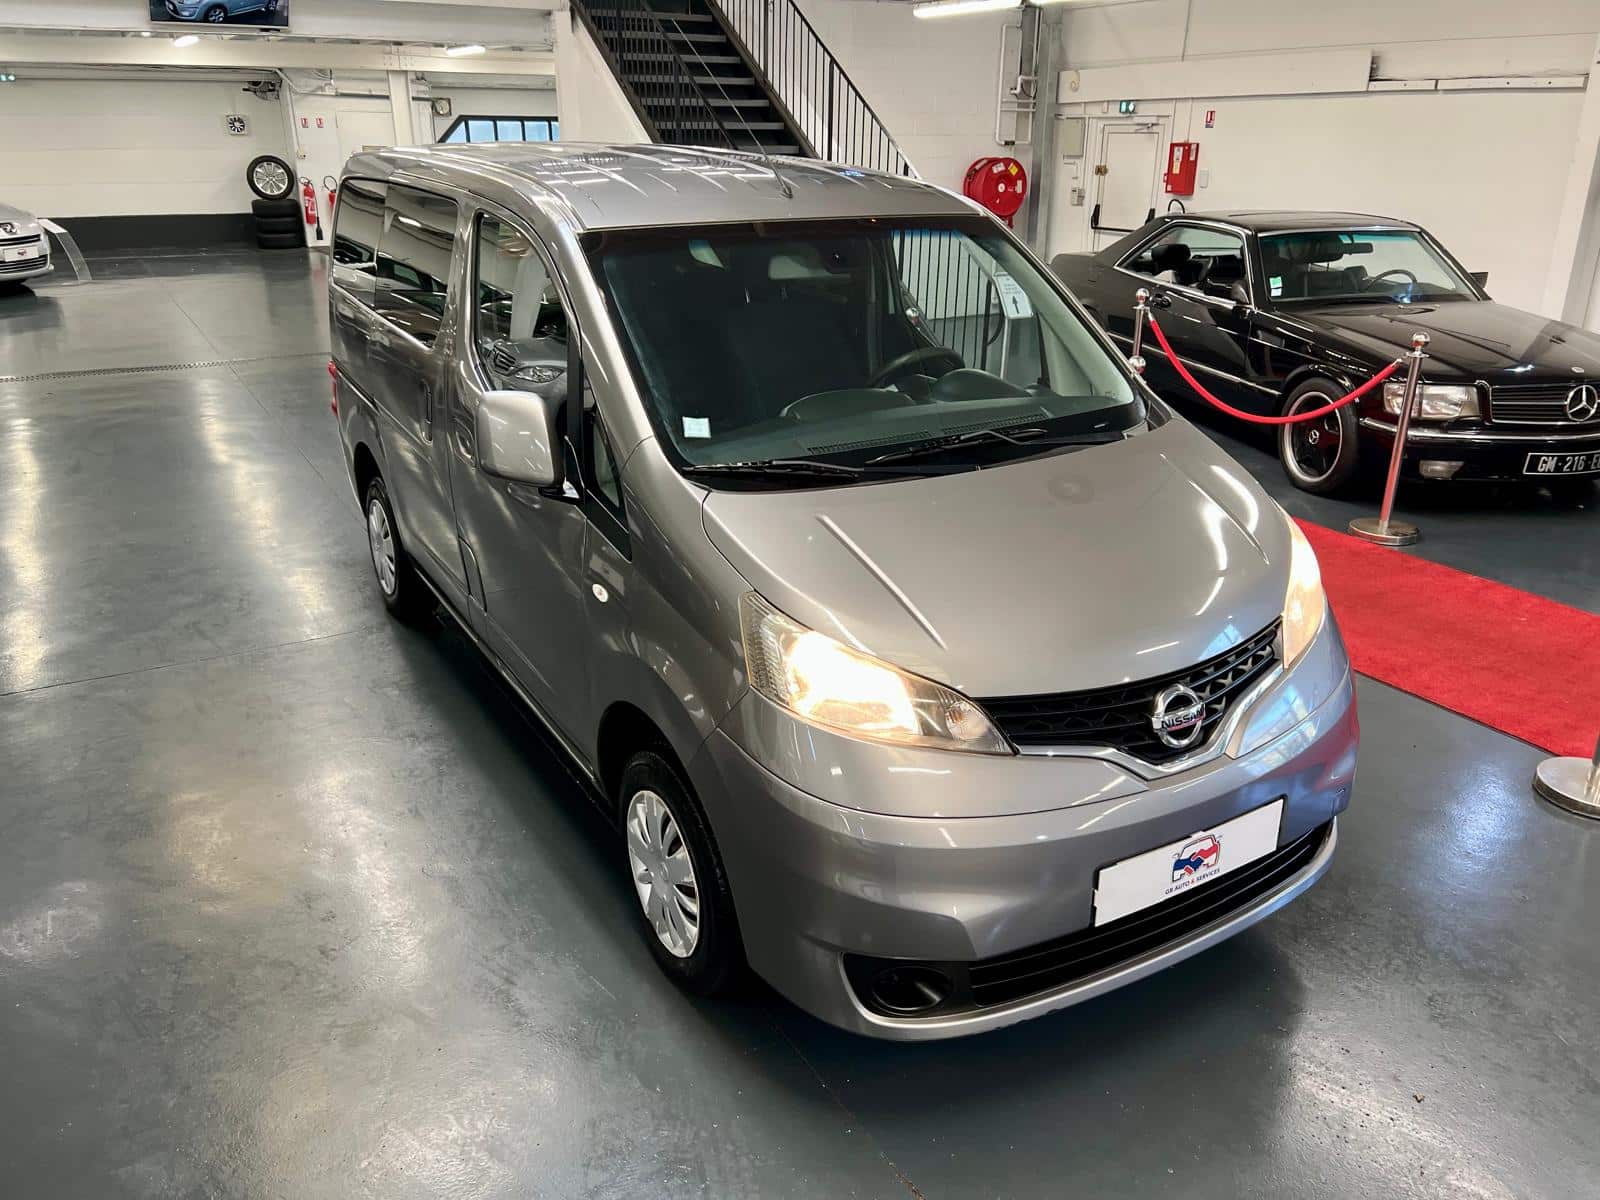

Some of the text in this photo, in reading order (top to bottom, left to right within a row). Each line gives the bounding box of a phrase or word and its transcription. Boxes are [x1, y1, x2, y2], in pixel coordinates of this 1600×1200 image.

[1161, 706, 1203, 730] NISSAN
[1174, 881, 1190, 891] AUTO
[1196, 869, 1220, 881] SERVICES
